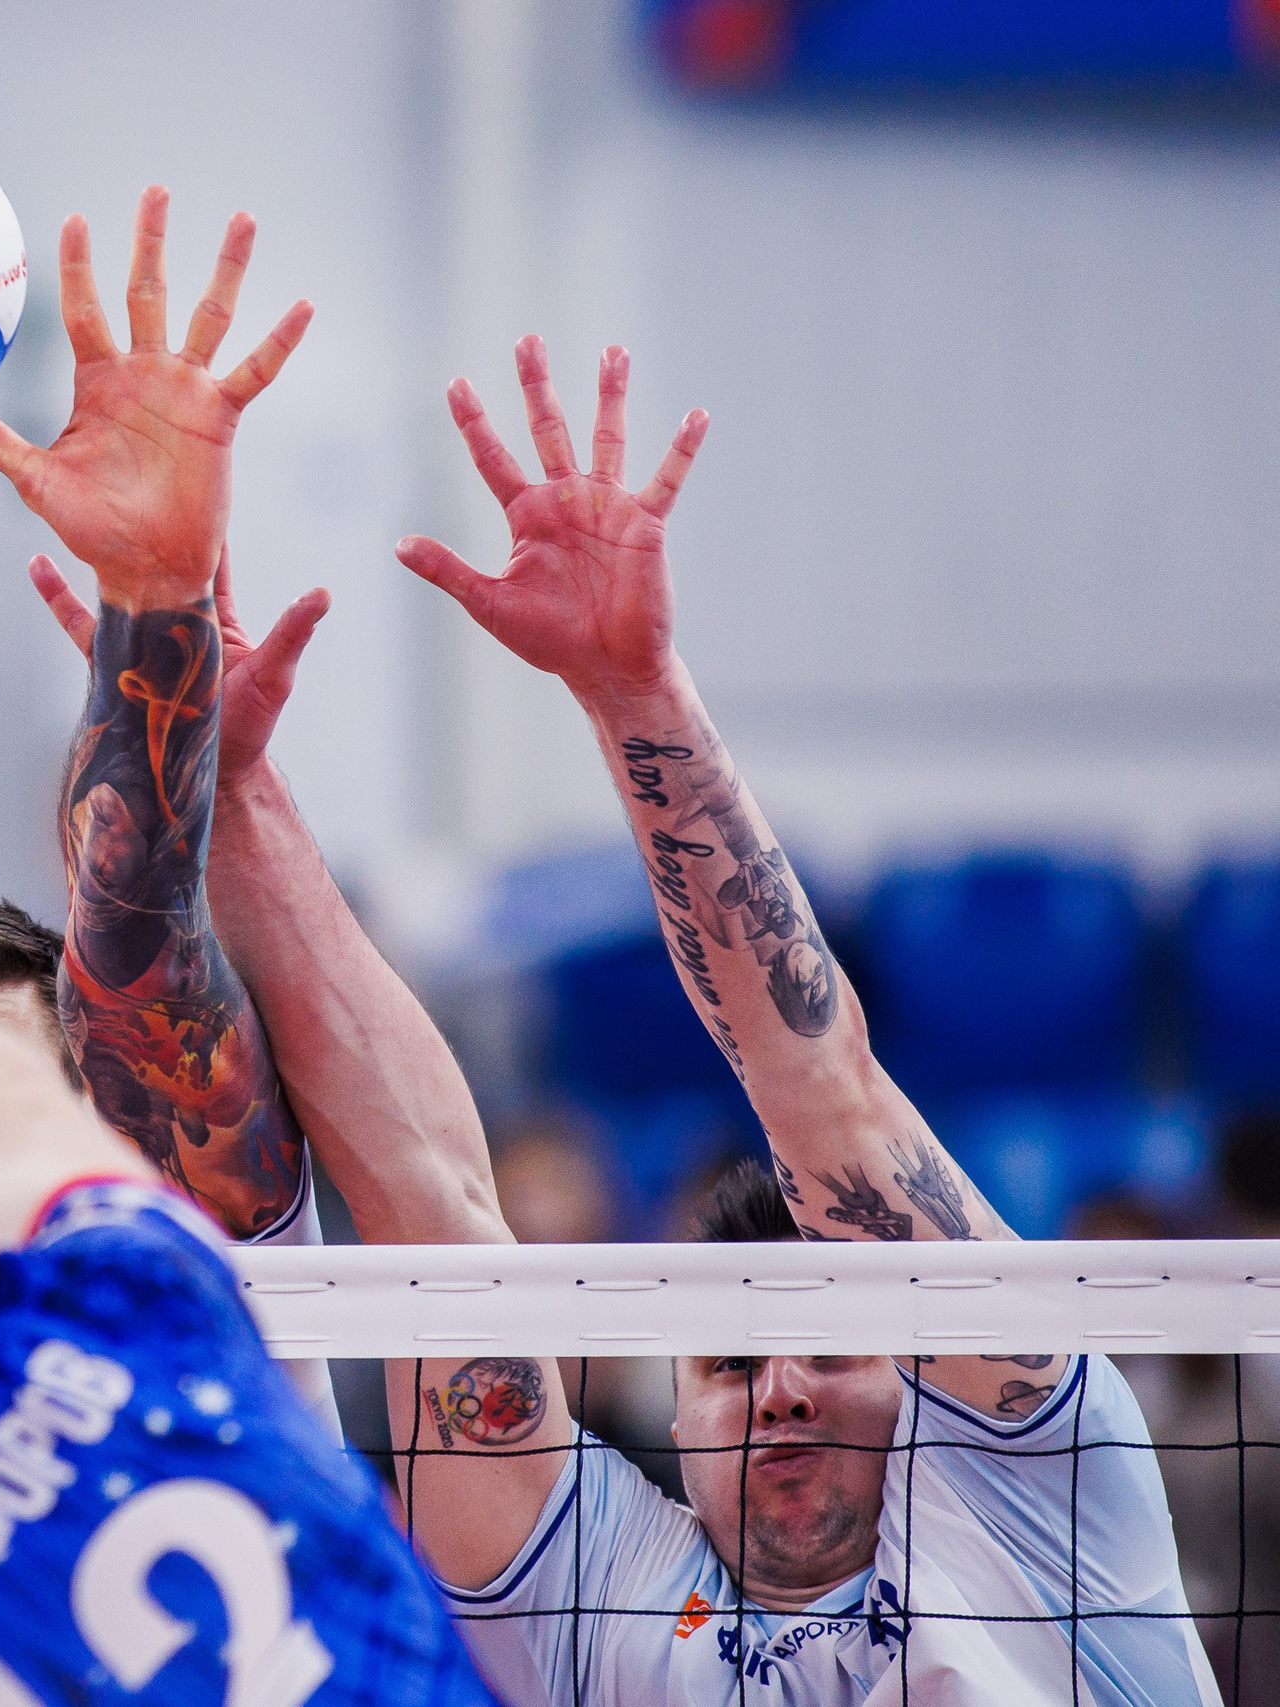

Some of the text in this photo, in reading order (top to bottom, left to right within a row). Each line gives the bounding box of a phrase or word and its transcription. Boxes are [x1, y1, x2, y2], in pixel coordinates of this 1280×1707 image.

[621, 736, 694, 808] say
[643, 829, 714, 911] they
[426, 1386, 455, 1449] TOKYO 2020
